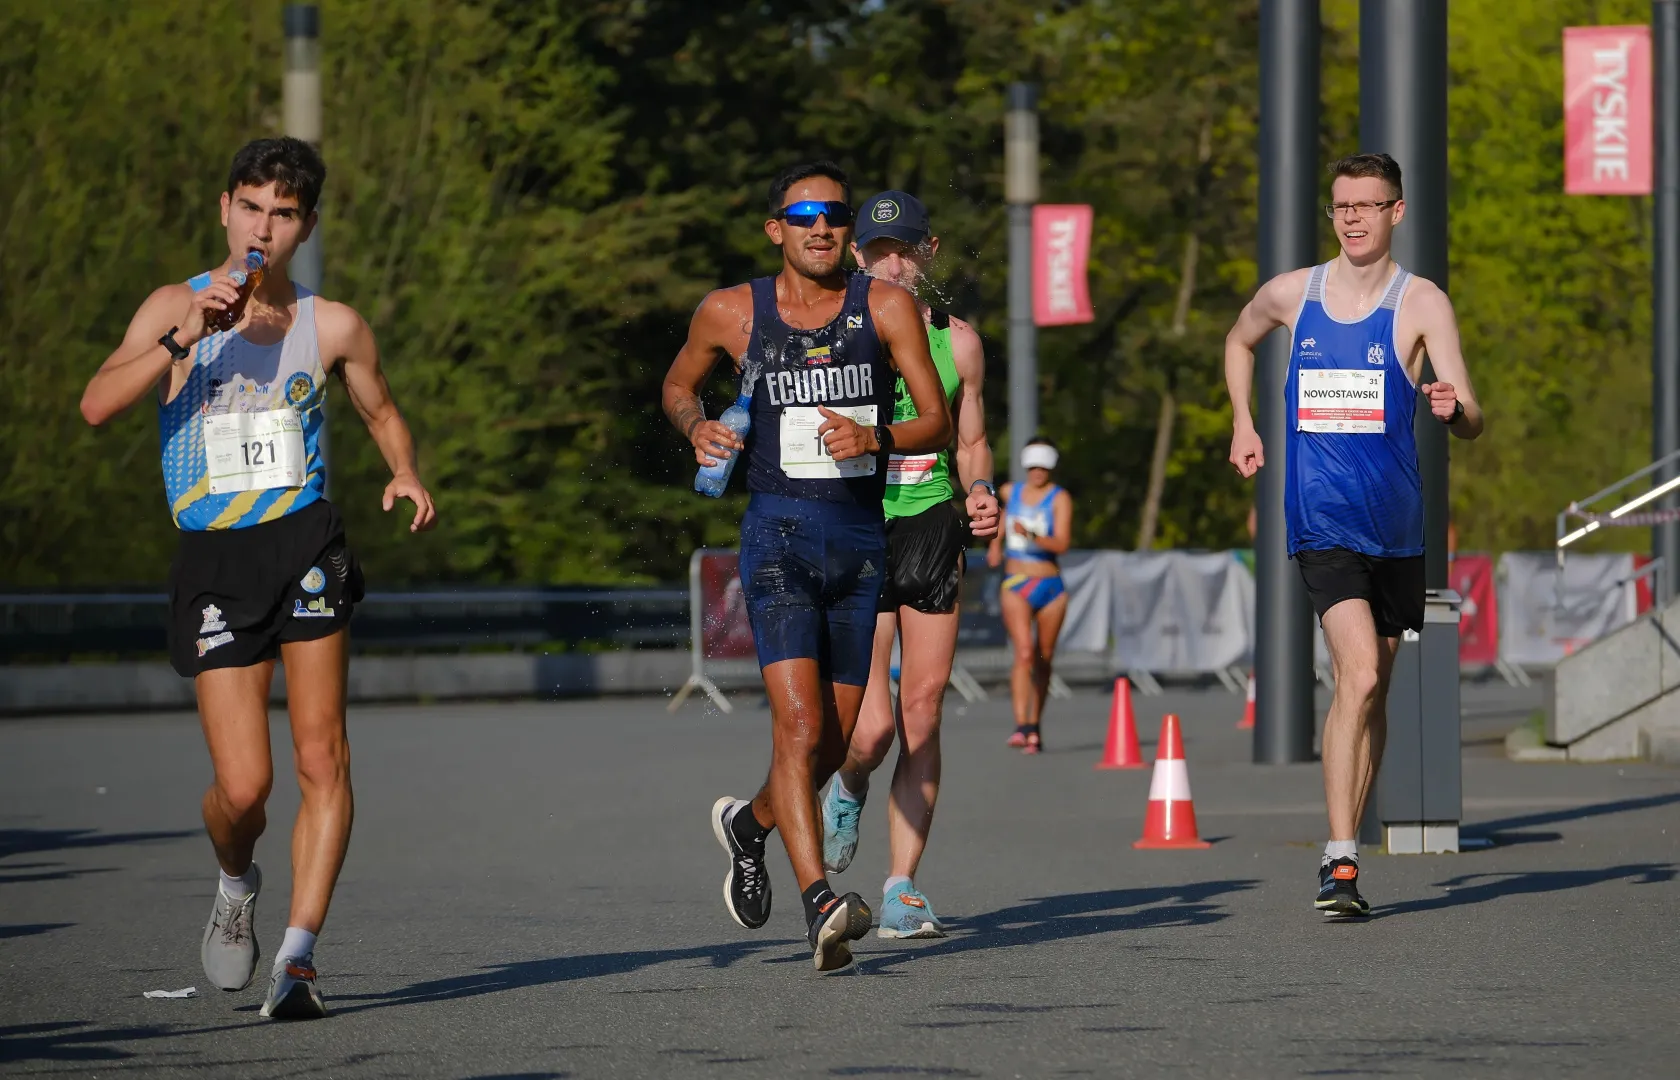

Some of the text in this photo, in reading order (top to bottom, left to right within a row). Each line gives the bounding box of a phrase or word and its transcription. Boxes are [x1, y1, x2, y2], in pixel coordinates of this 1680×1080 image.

[1593, 41, 1628, 182] TYSKIE
[1048, 216, 1077, 315] TYSKIE
[765, 364, 873, 406] ECUADOR
[1304, 389, 1378, 399] NOWOSTAWSKI
[241, 440, 275, 466] 121
